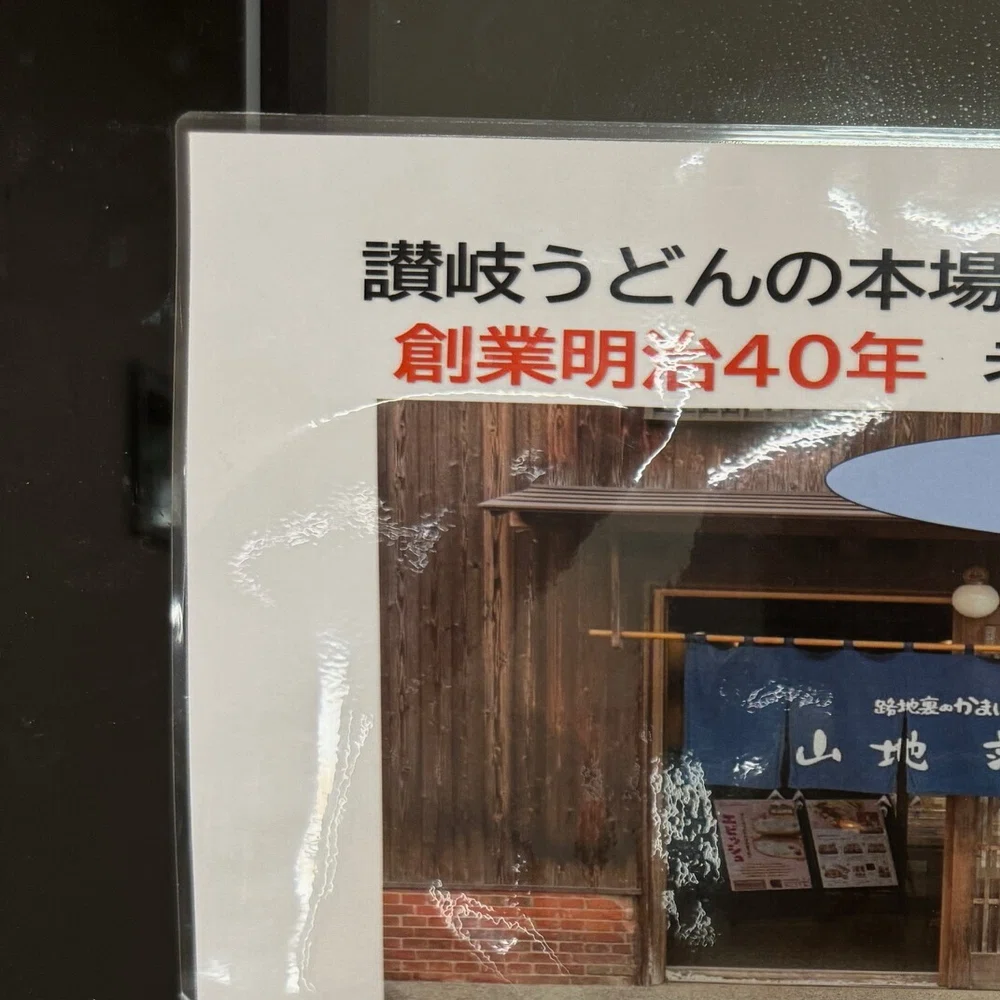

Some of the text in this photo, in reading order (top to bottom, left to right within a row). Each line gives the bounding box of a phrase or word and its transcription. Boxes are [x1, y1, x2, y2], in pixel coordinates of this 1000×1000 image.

[393, 322, 927, 394] 創業明治40年
